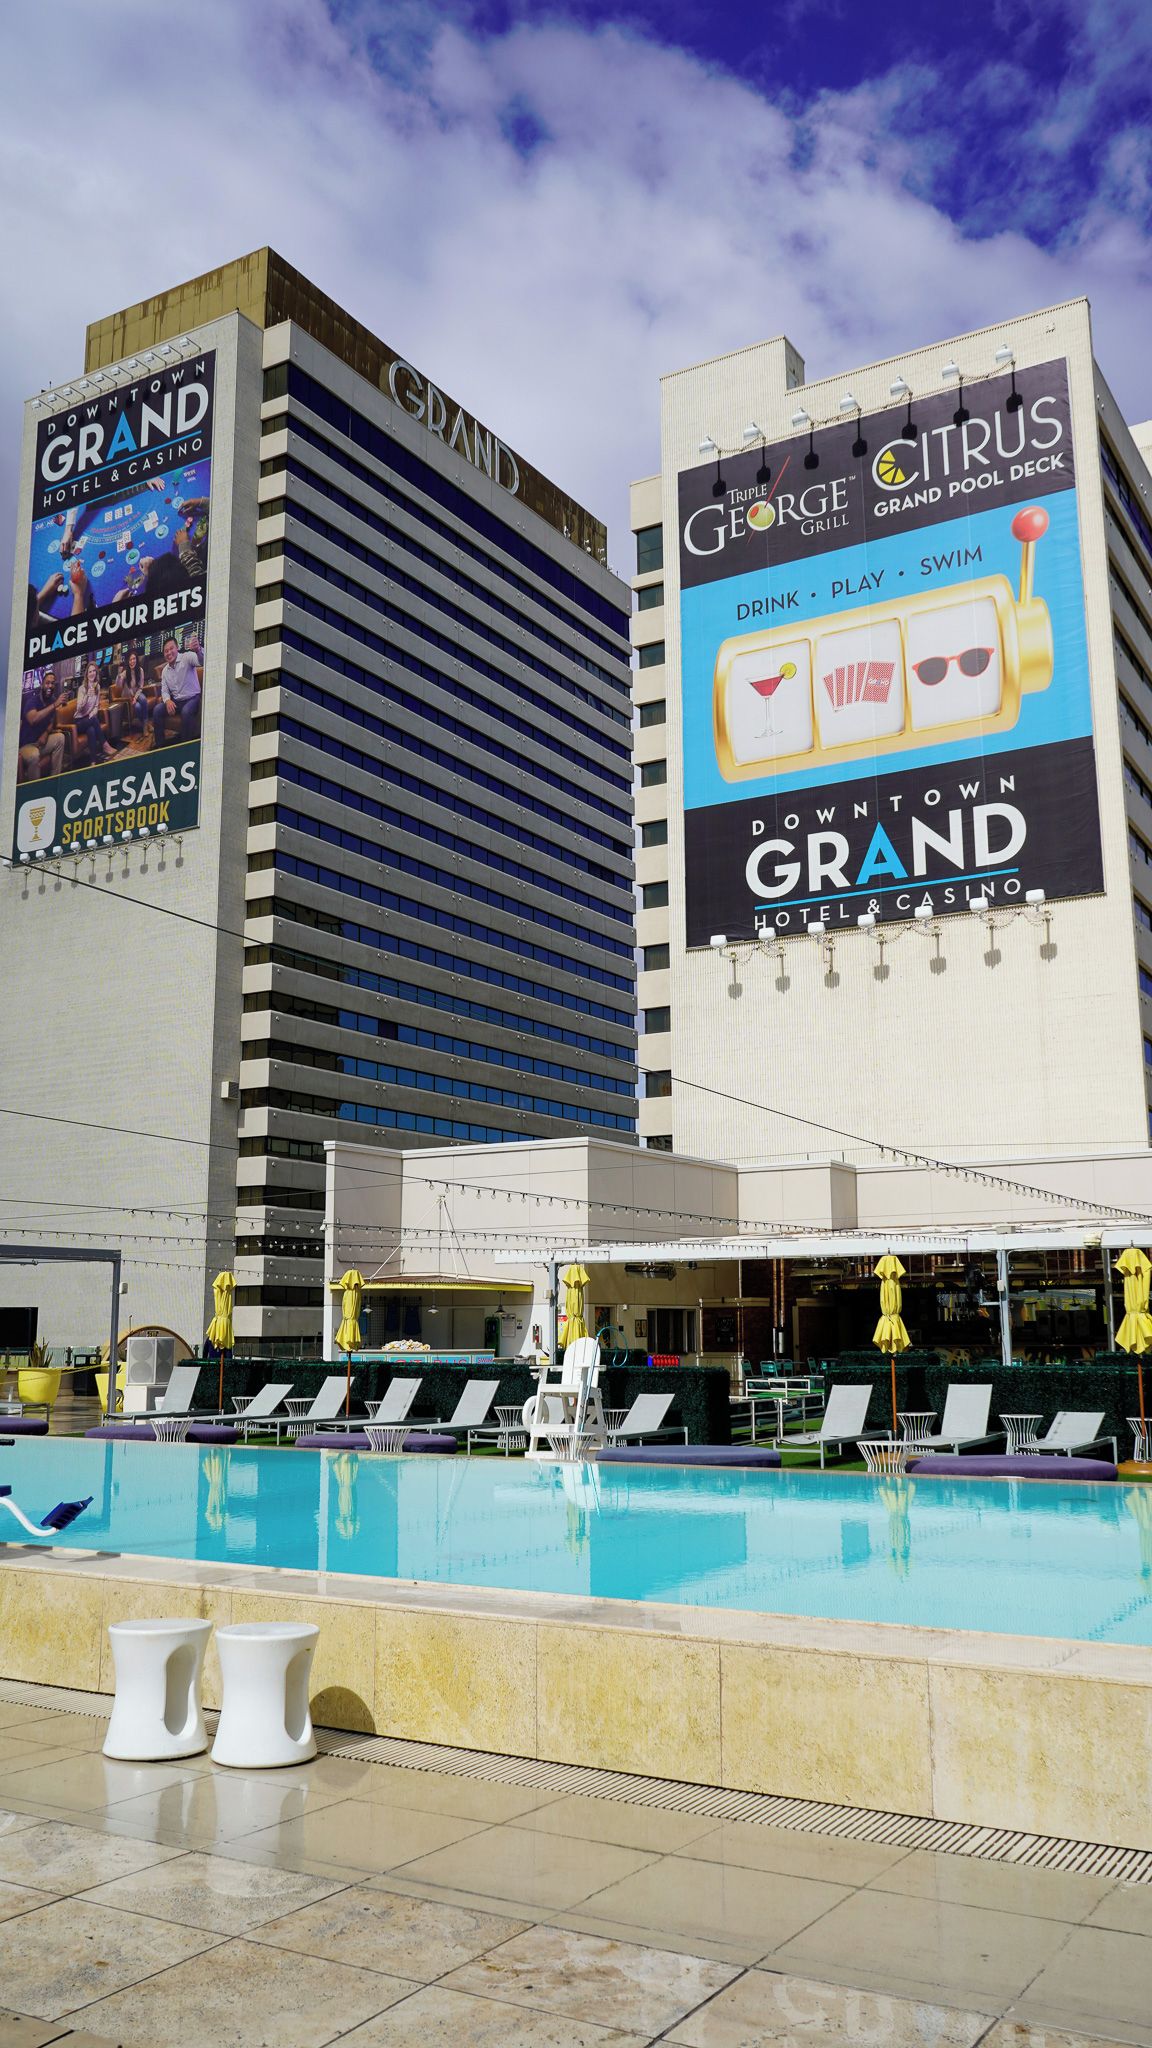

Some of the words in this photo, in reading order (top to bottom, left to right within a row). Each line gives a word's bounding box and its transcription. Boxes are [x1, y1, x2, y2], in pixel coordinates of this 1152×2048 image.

[41, 382, 209, 483] GRAND
[47, 361, 205, 436] DOWNTOWN
[388, 359, 520, 496] GRAND
[43, 480, 101, 508] HOTEL
[111, 469, 119, 482] &
[129, 438, 202, 475] CASINO
[871, 395, 1063, 491] CITRUS
[726, 483, 768, 505] TRIPLE
[873, 487, 942, 517] GRAND
[949, 470, 1004, 498] POOL
[1010, 452, 1065, 481] DECK
[800, 513, 849, 536] GRILL
[736, 589, 800, 621] DRINK
[831, 569, 885, 599] PLAY
[920, 545, 983, 575] SWIM
[28, 621, 87, 658] PLACE
[93, 604, 148, 639] YOUR
[153, 585, 203, 621] BETS
[62, 800, 170, 845] SPORTSBOOK
[63, 761, 196, 819] CAESARS
[751, 774, 1016, 836] DOWNTOWN
[745, 801, 1027, 899] GRAND
[754, 903, 850, 931] HOTEL
[867, 898, 881, 914] &
[896, 878, 1021, 911] CASINO
